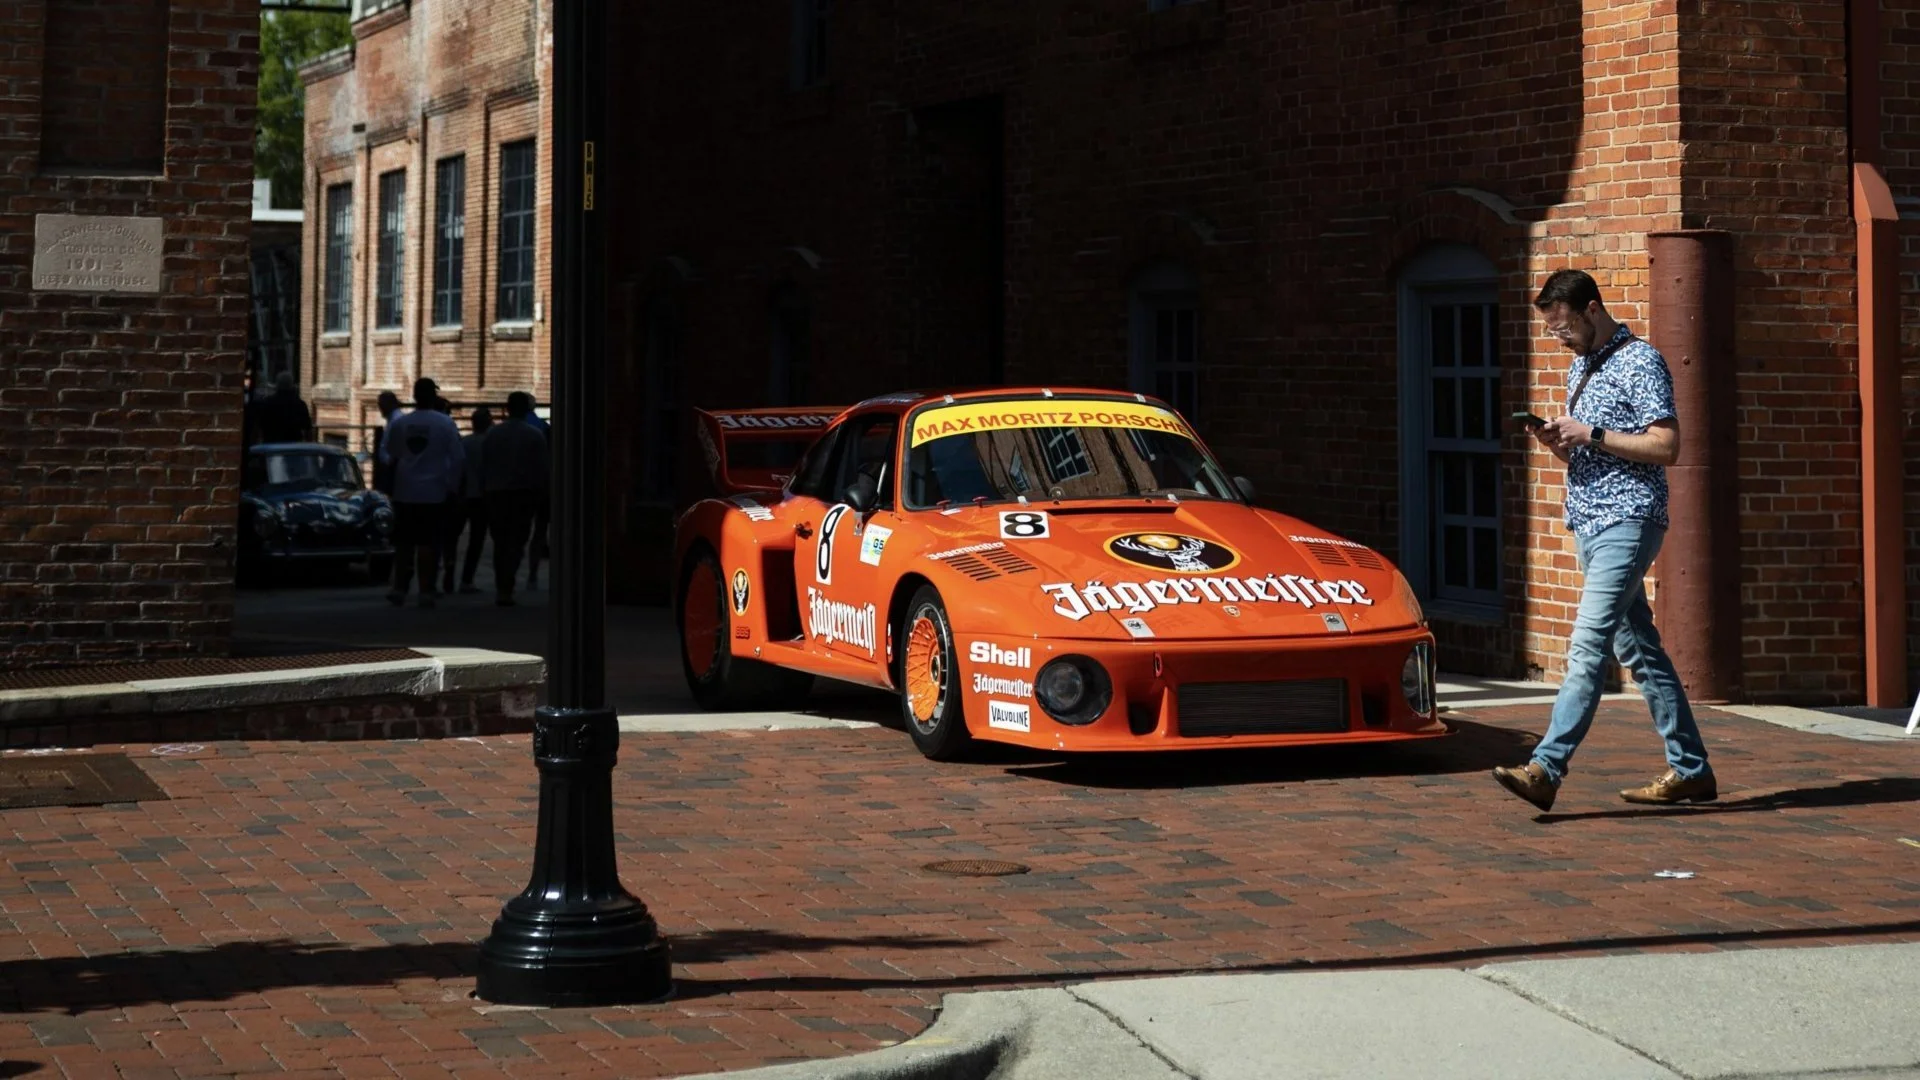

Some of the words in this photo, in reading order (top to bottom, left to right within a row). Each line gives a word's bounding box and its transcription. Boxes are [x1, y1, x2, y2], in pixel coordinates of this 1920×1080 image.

[63, 245, 115, 255] TOBACCO
[67, 258, 125, 271] 1901-2
[916, 416, 976, 441] MAX
[978, 412, 1077, 428] MORITZ
[1003, 513, 1046, 537] 8
[818, 506, 846, 580] 8
[1040, 573, 1375, 621] Jägermeister
[969, 640, 1031, 668] Shell
[991, 705, 1029, 728] VALVOLINE
